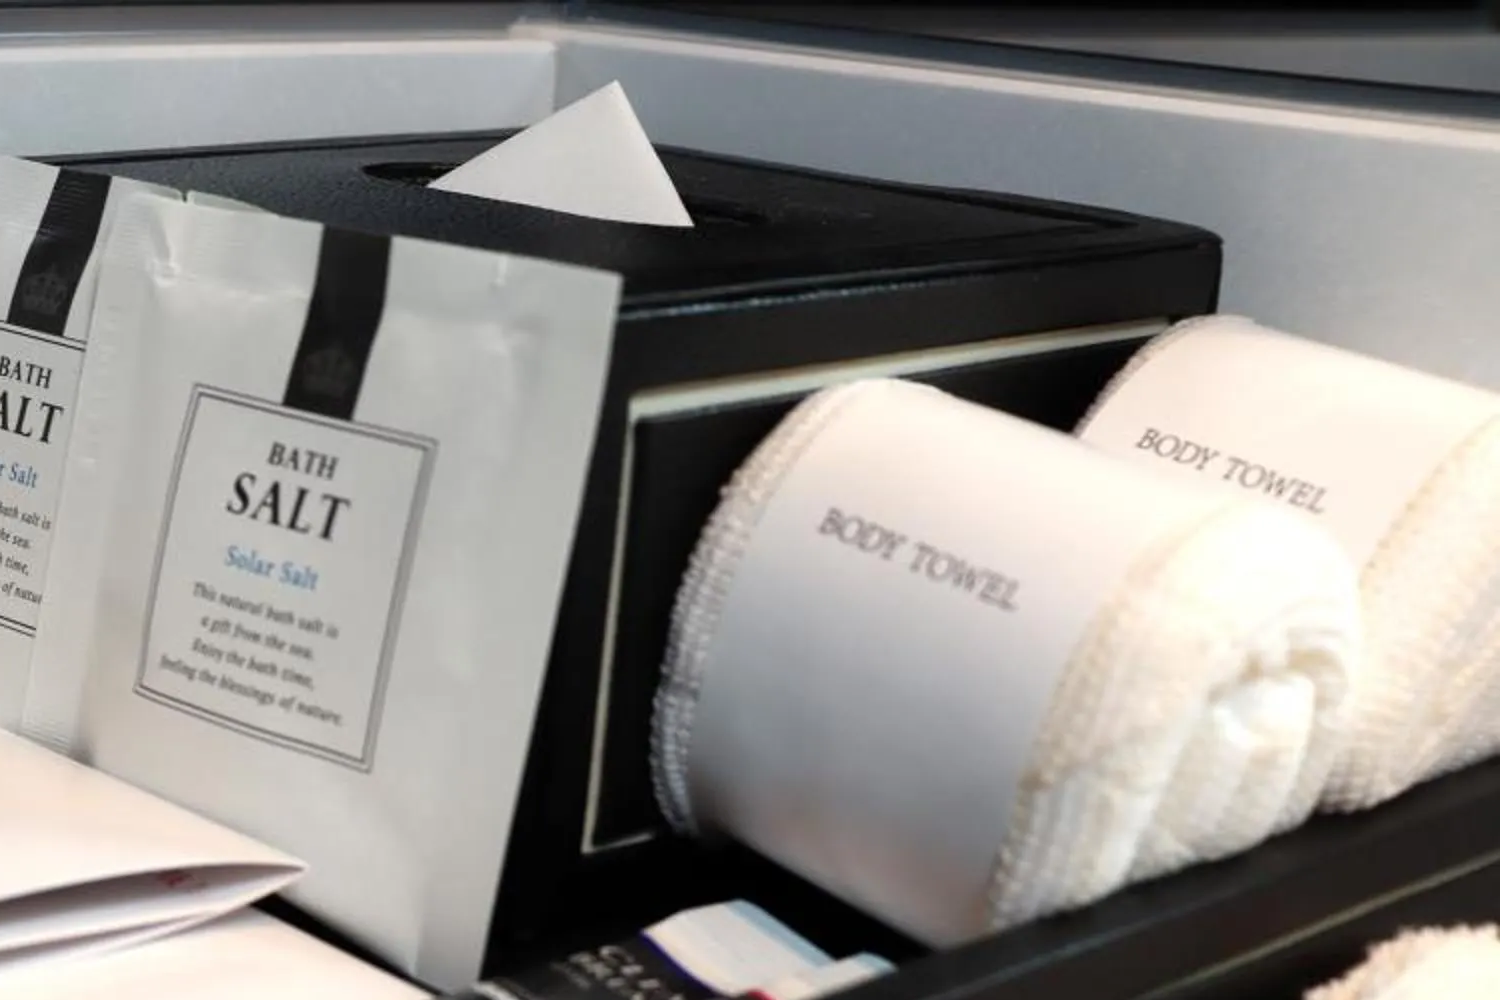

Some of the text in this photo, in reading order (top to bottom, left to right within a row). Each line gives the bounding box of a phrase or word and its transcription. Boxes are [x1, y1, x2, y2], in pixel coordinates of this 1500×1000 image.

[8, 462, 38, 488] Salt
[267, 442, 339, 481] BATH
[1135, 427, 1328, 515] BODY TOWEL
[21, 511, 40, 527] salt
[226, 472, 352, 542] SALT
[224, 545, 319, 592] Solar Salt
[817, 507, 1022, 613] BODY TOWEL
[1, 581, 15, 596] of
[193, 581, 217, 601] This
[220, 592, 264, 616] natural
[266, 605, 295, 625] bath
[298, 617, 324, 634] salt
[201, 616, 210, 627] a
[210, 618, 232, 635] gift
[232, 622, 261, 643] from
[265, 633, 287, 651] the
[192, 637, 223, 663] Enjoy
[225, 650, 246, 668] the
[247, 655, 278, 677] bath
[159, 654, 197, 681] feeling
[199, 668, 218, 686] the
[219, 674, 276, 706] blessings
[278, 696, 297, 713] of
